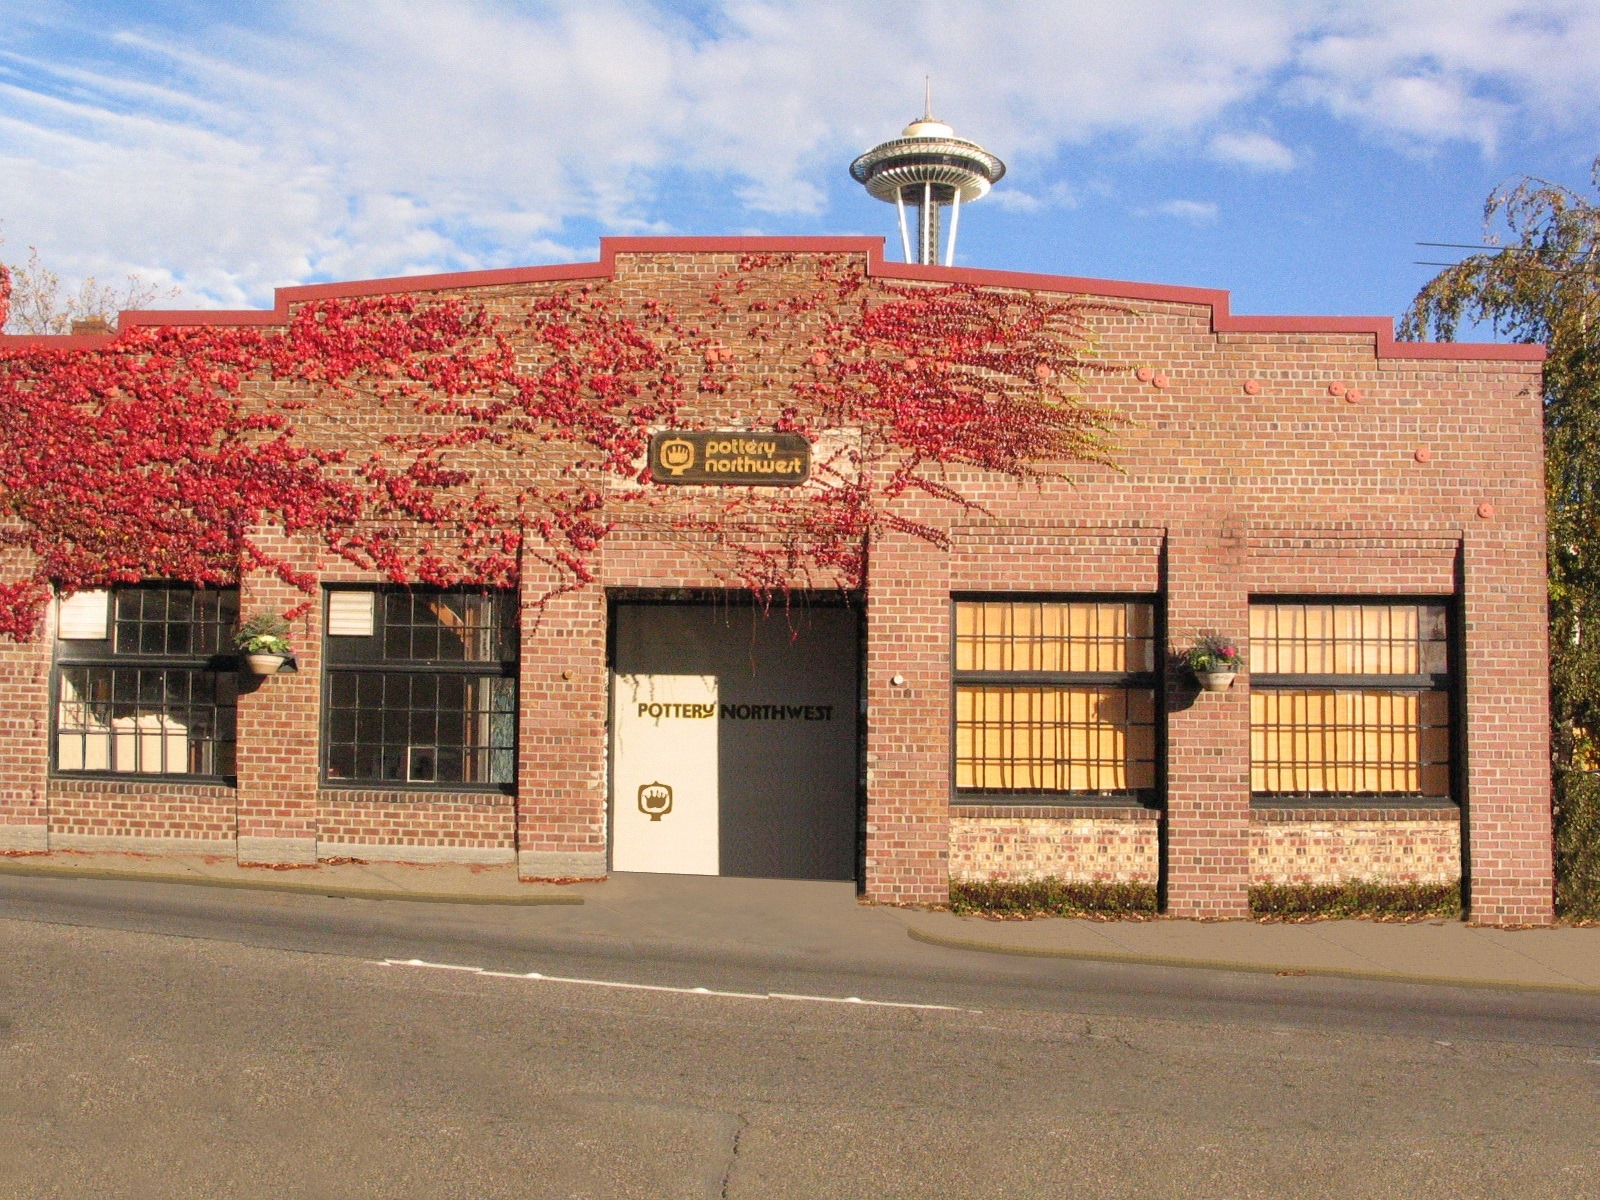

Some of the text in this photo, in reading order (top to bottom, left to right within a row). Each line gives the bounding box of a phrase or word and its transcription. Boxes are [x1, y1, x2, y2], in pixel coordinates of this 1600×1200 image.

[705, 439, 776, 458] pottery
[704, 456, 801, 473] northwest
[638, 702, 834, 721] POTTERY NORTHWEST
